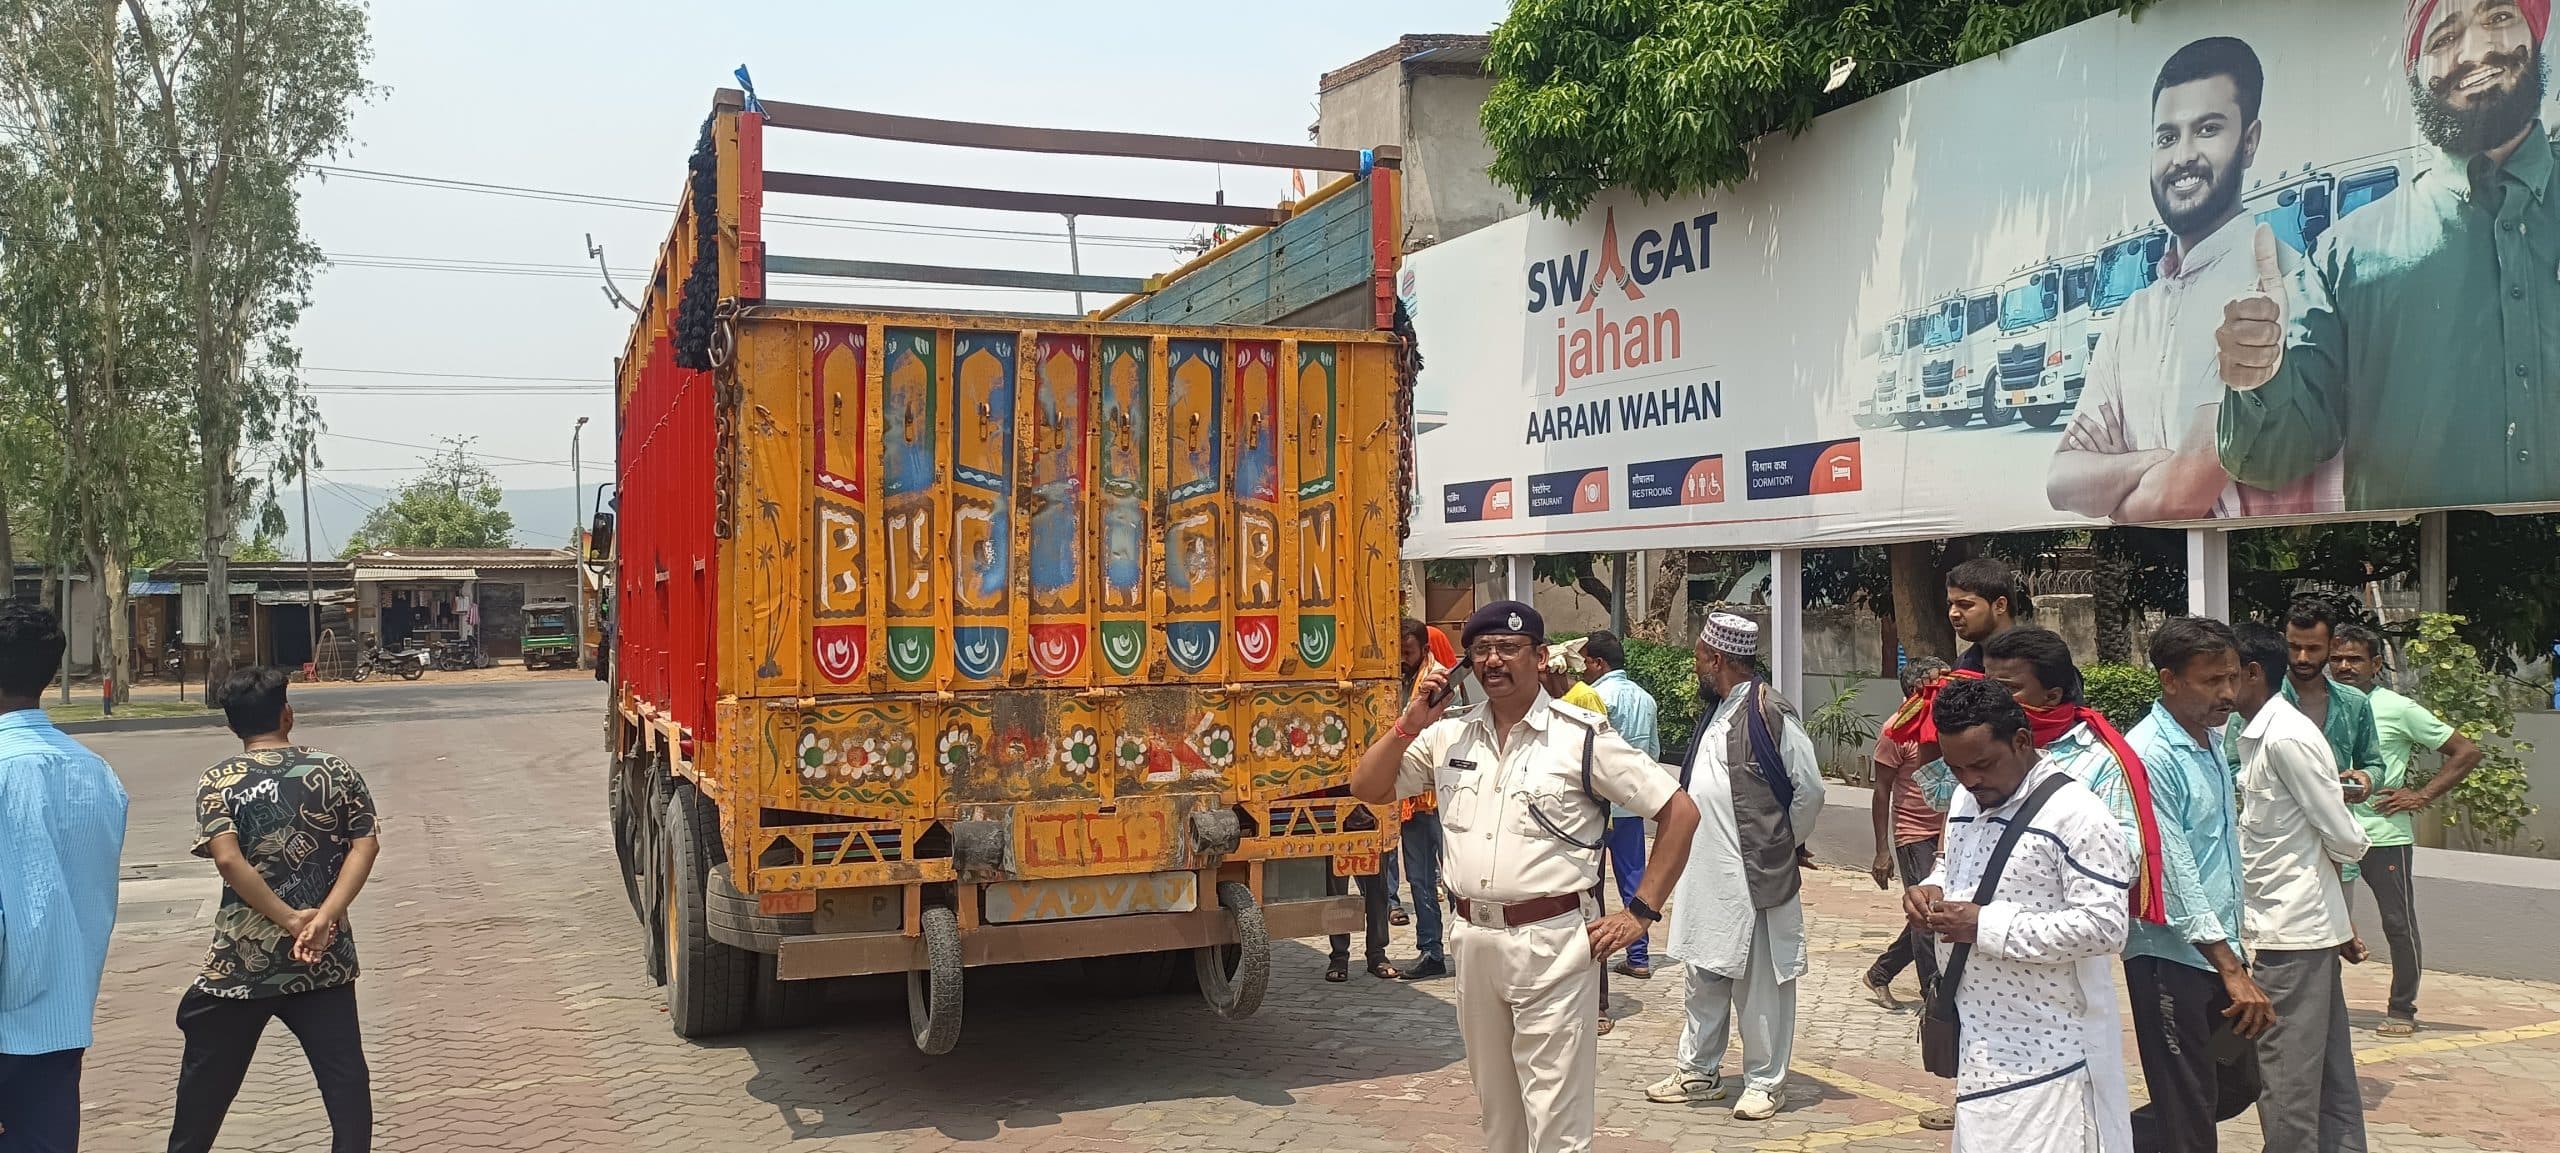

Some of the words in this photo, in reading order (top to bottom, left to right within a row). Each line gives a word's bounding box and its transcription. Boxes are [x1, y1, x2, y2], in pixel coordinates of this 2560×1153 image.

[1555, 308, 1681, 396] jahan
[1526, 398, 1611, 445] AARAM
[1618, 381, 1721, 432] WAHAN
[1752, 475, 1794, 488] DORMITORY
[1632, 487, 1673, 498] RESTROOMS
[1531, 496, 1563, 508] RESTAURANT
[1446, 505, 1467, 515] PARKING
[1025, 811, 1166, 868] TATA
